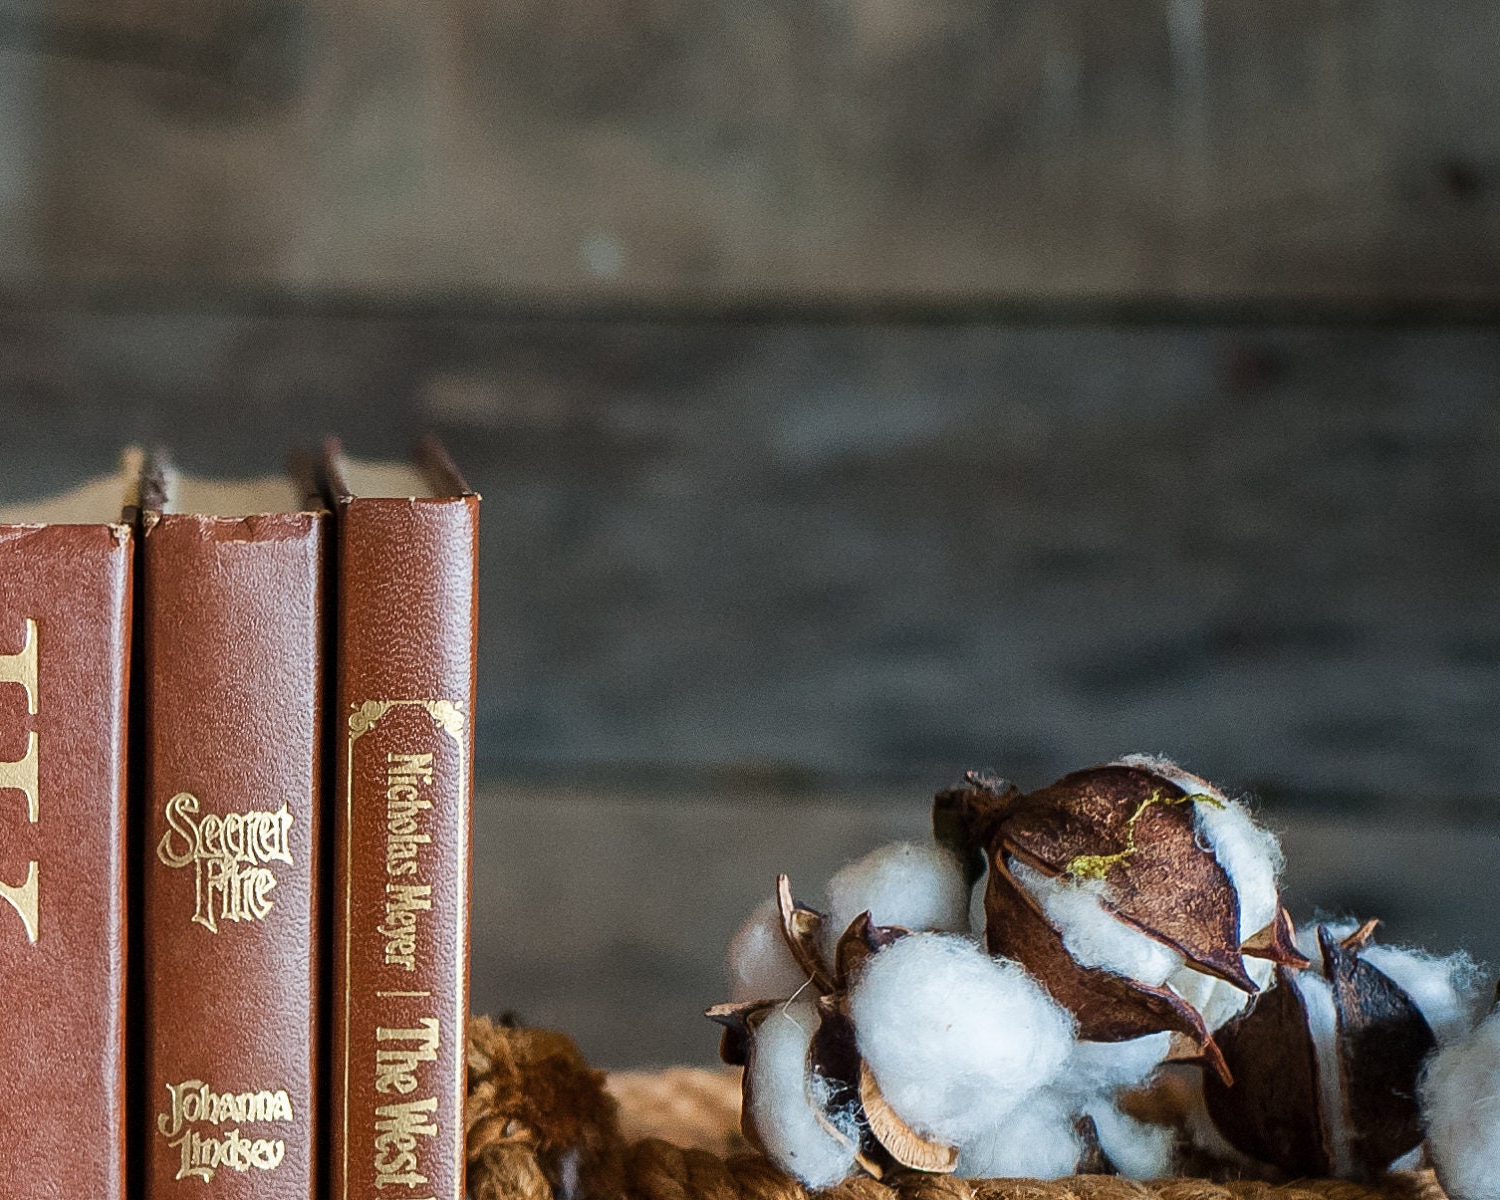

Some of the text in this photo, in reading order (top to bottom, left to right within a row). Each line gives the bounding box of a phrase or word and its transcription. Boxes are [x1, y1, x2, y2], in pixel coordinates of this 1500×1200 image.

[156, 791, 294, 868] Secret
[386, 751, 436, 876] Nicholas
[191, 857, 278, 934] Fire
[376, 883, 434, 972] Meyer
[375, 1016, 442, 1095] The
[157, 1079, 294, 1138] Johanna
[373, 1096, 440, 1191] West
[168, 1128, 286, 1184] Lindsey
